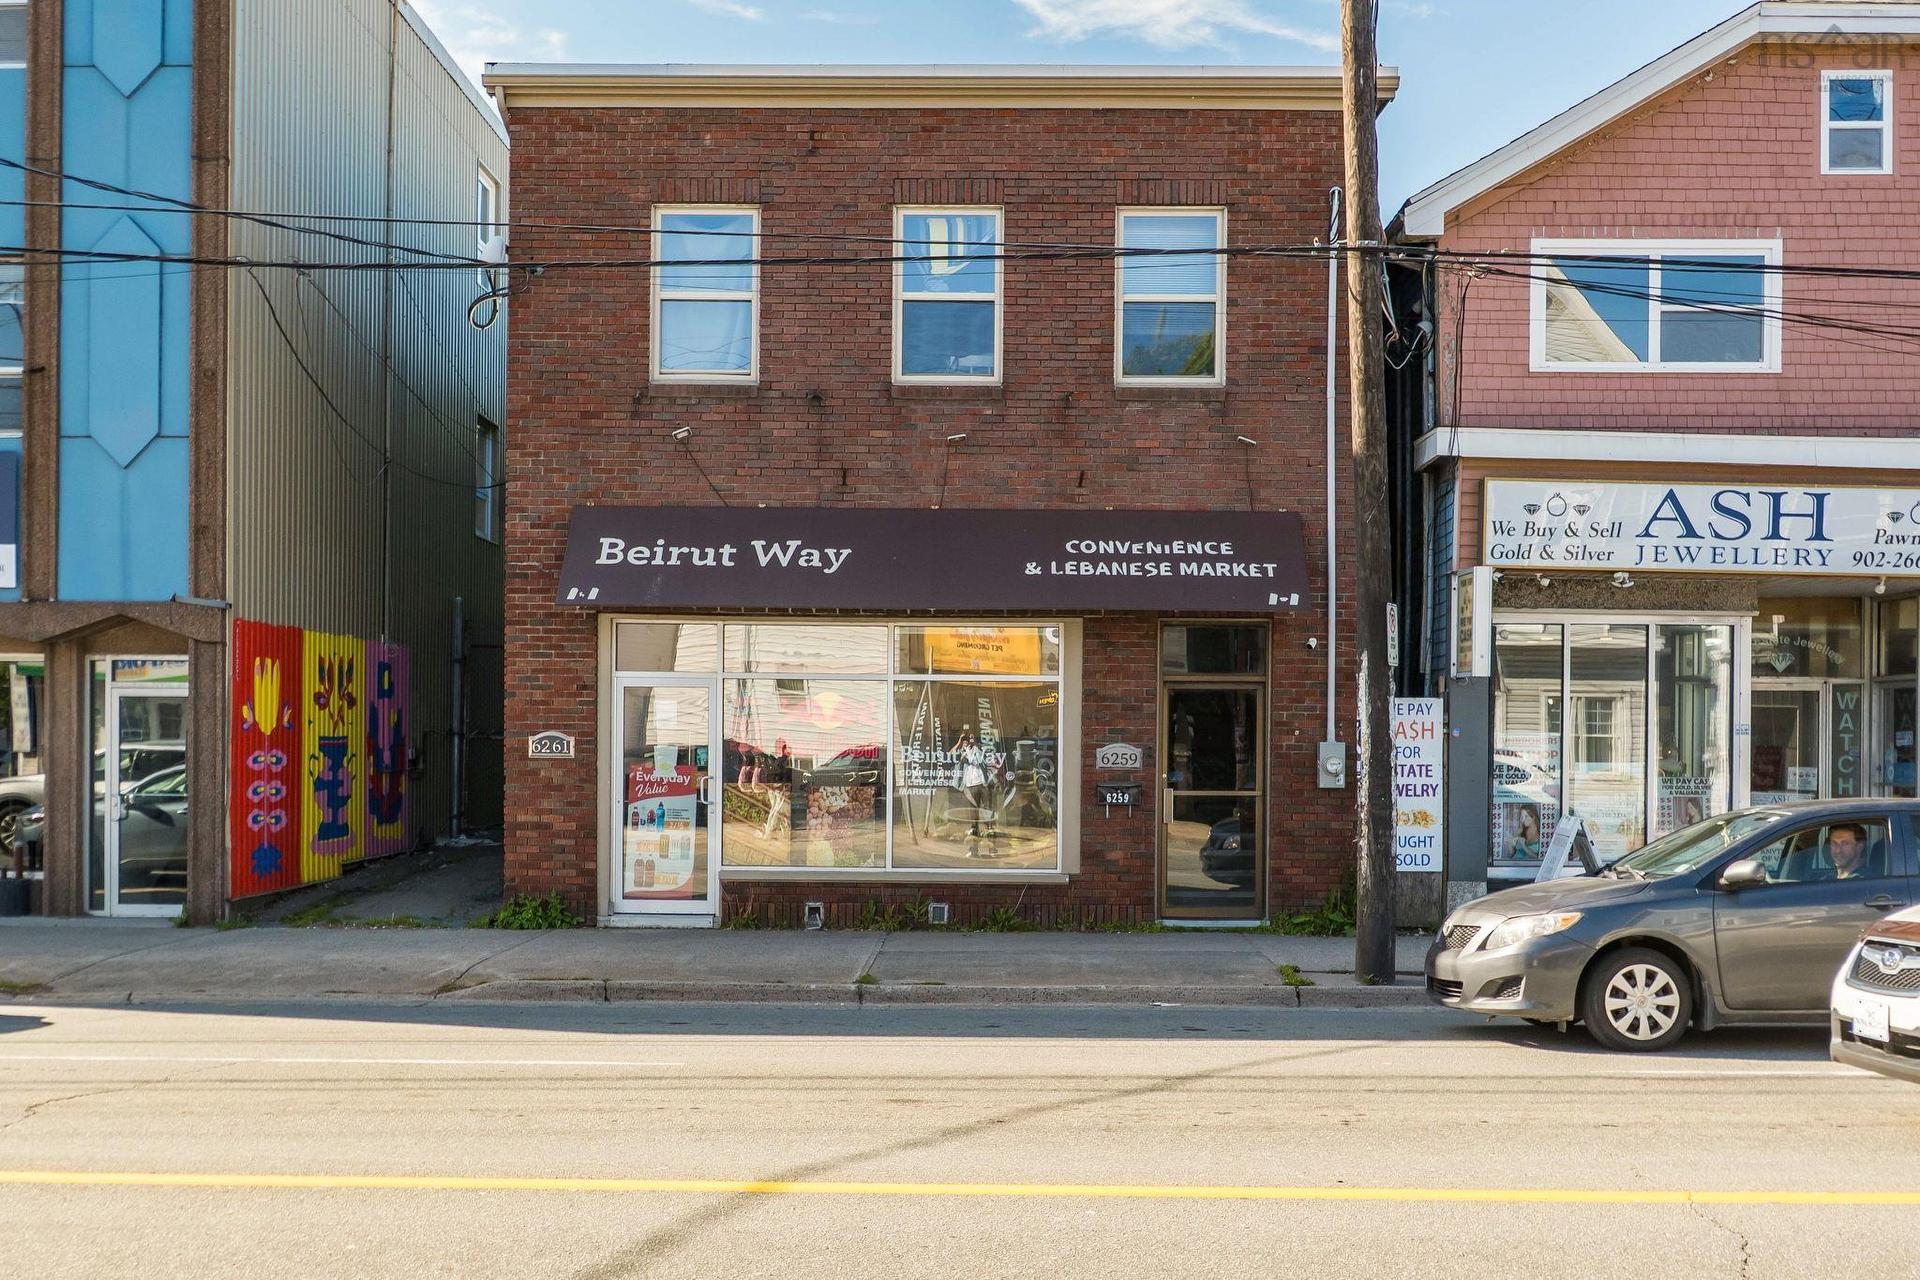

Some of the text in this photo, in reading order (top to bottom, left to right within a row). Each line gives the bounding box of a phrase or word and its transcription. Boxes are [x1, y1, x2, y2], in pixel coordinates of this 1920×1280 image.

[1635, 488, 1834, 542] ASH
[1491, 520, 1623, 542] We Buy & Sell
[1065, 540, 1234, 555] CONVENIENCE
[1490, 543, 1615, 561] Gold & Silver
[595, 537, 852, 574] Beirut Way
[1635, 545, 1833, 567] JEWELLERY
[1024, 561, 1278, 578] & LEBANESE MARKET
[1408, 703, 1433, 716] PAY
[1395, 720, 1434, 742] A$H
[532, 739, 570, 753] 6261
[1395, 746, 1421, 759] FOR
[900, 745, 960, 763] Beirut
[1101, 752, 1138, 766] 6259
[1396, 764, 1433, 778] TATE
[1507, 764, 1526, 773] PA
[1661, 777, 1674, 785] WE
[1676, 777, 1693, 785] PAY
[635, 783, 669, 798] Value
[898, 788, 937, 796] MARKET
[1106, 792, 1129, 803] 6259
[1396, 783, 1440, 798] WELRY
[1398, 835, 1435, 849] UGHT
[1396, 853, 1431, 867] SOLD
